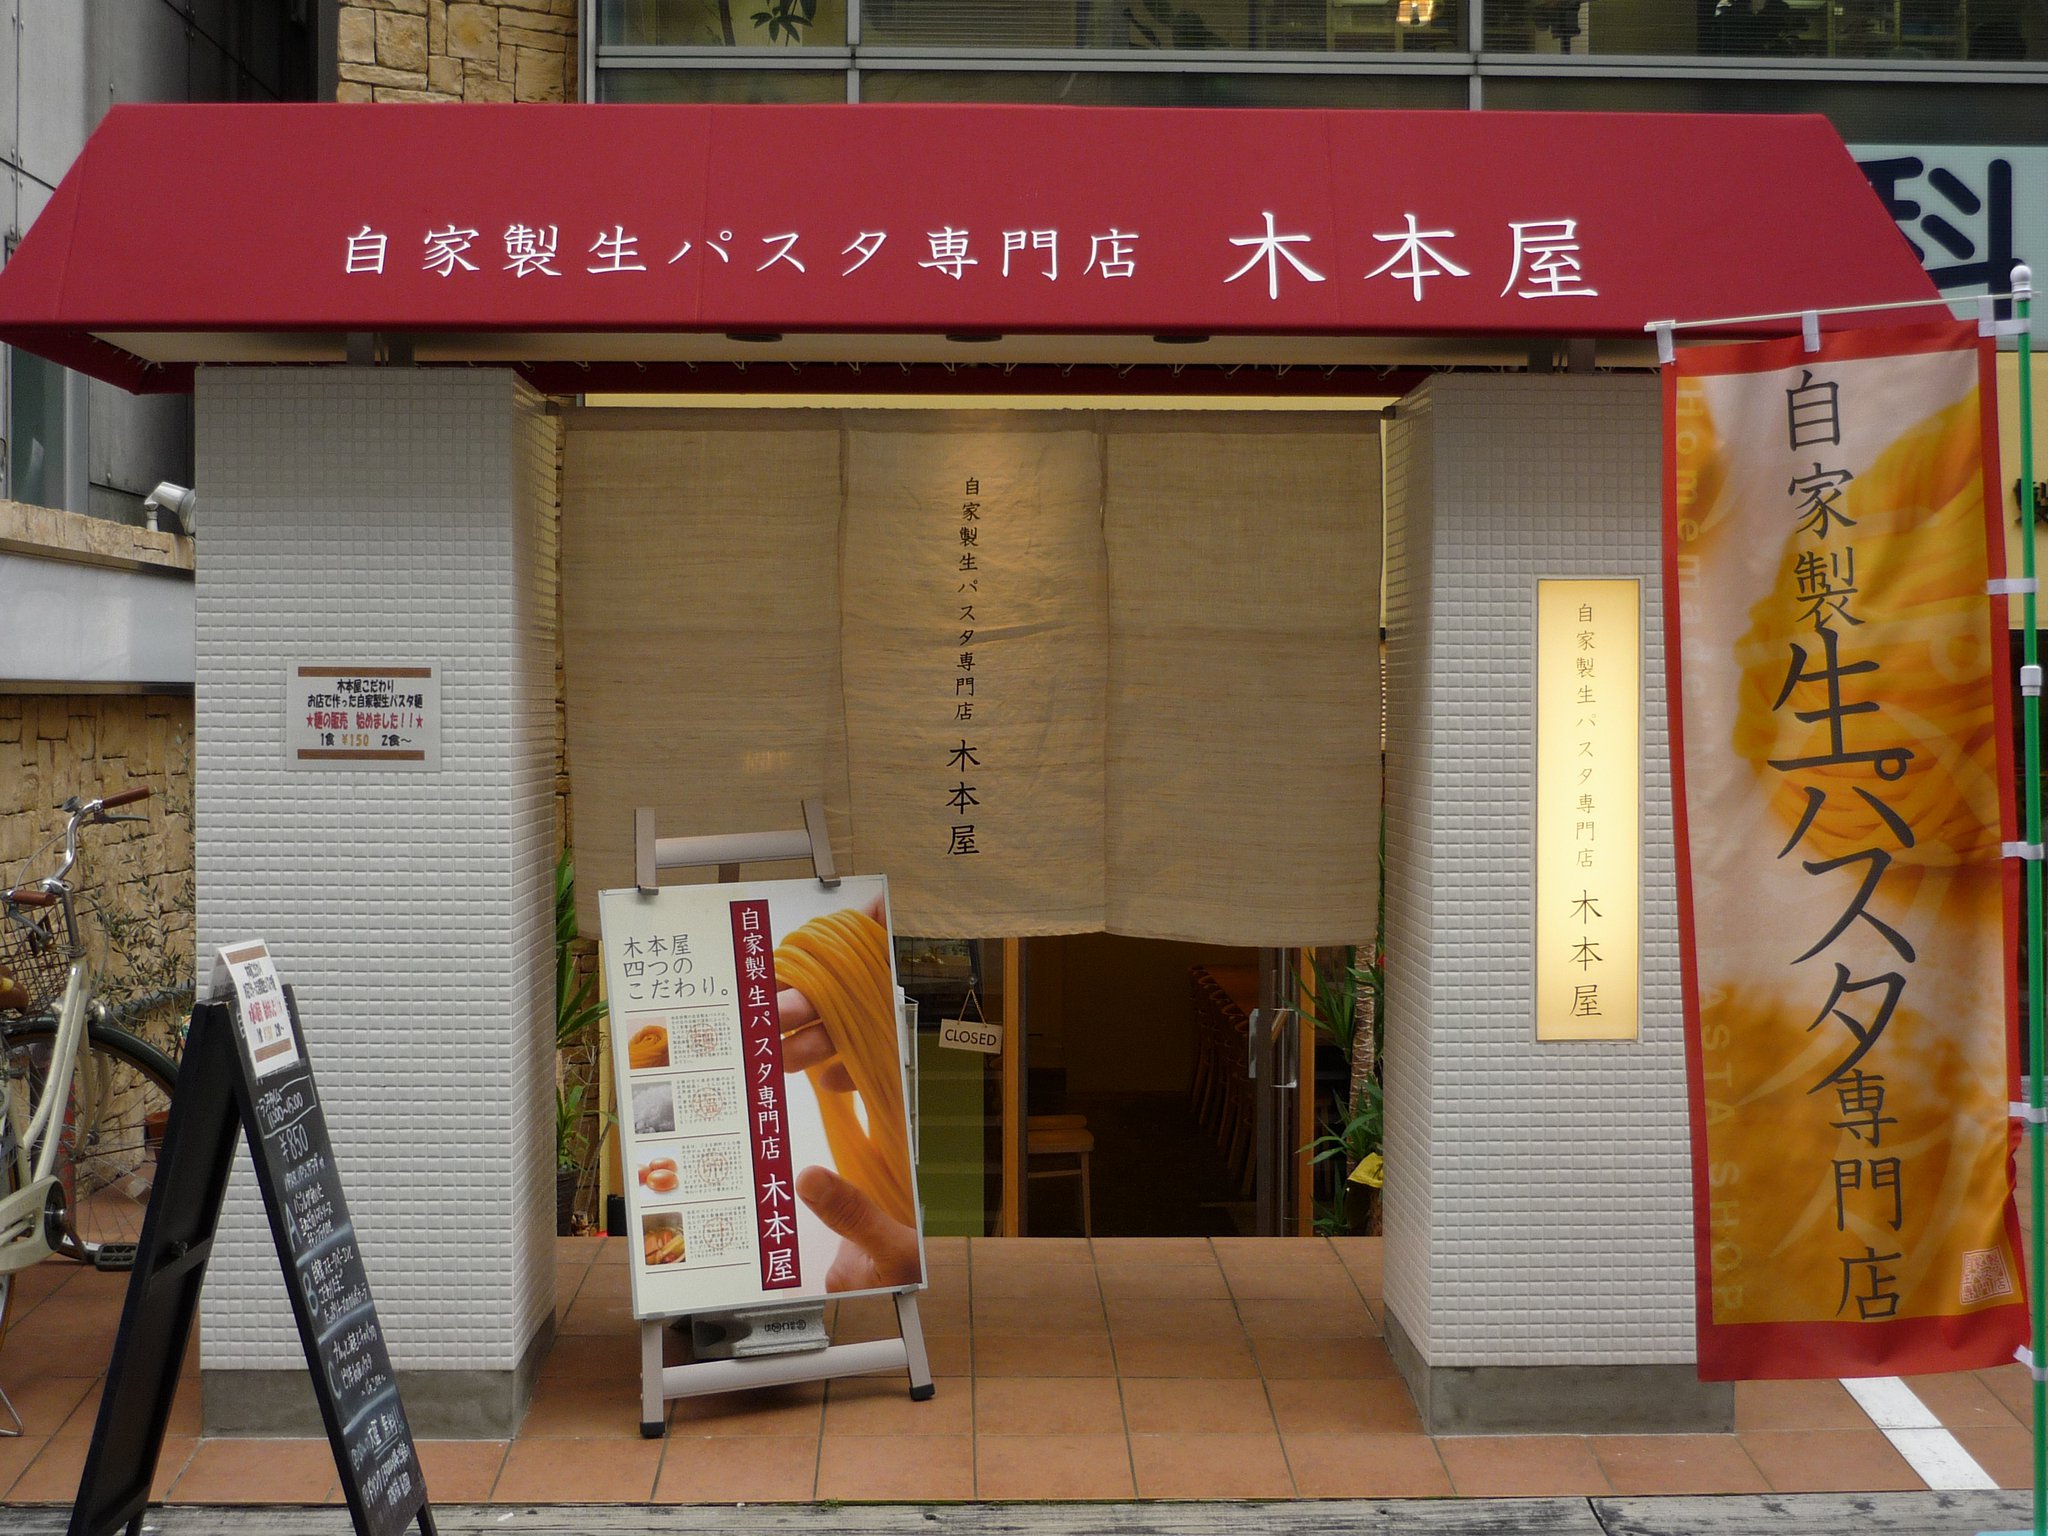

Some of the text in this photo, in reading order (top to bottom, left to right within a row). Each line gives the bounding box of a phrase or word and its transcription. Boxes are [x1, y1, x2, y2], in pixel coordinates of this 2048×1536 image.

[345, 211, 1598, 302] 自家製生パスタ専門店 木本屋
[337, 679, 395, 693] 木本屋こだわり
[946, 477, 981, 855] 自家製生パスタ専門店 木本屋
[1569, 603, 1603, 1017] 自家製生パスタ専門店 木本屋
[1767, 370, 1915, 1320] 自家製生パスタ専門店
[623, 934, 692, 958] 木本屋
[623, 957, 693, 978] 四つの
[628, 976, 729, 1000] こだわり。
[740, 907, 781, 1160] 自家製生パスタ専門店
[944, 1029, 997, 1046] CLOSED
[279, 1123, 309, 1163] ¥850
[285, 1203, 302, 1253] A
[760, 1172, 796, 1283] 木本屋
[1712, 1161, 1745, 1309] SHOP
[303, 1271, 319, 1318] B
